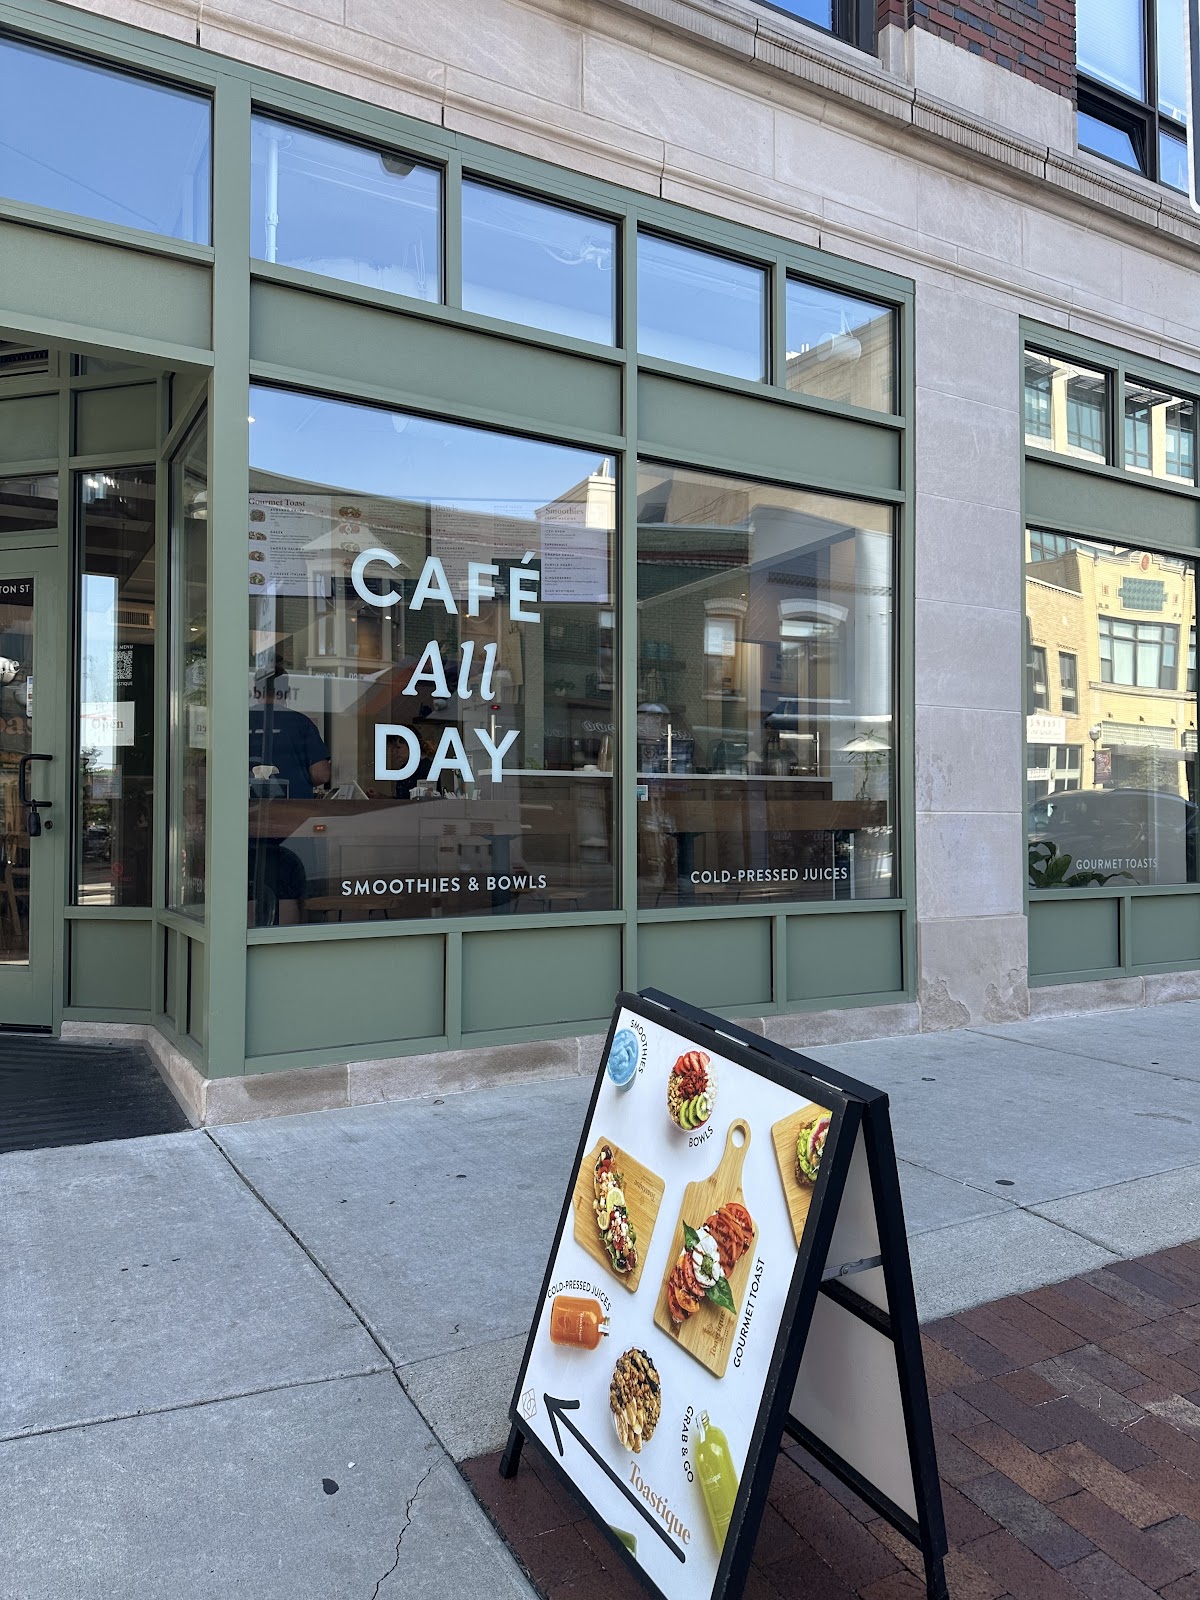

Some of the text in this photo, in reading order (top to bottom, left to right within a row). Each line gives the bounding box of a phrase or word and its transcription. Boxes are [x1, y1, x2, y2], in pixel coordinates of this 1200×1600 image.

[284, 499, 306, 507] Toast
[435, 504, 458, 512] Bowls
[545, 507, 584, 515] Smoothies
[20, 584, 30, 593] ST
[351, 547, 541, 624] CAFÉ
[401, 640, 498, 701] All
[92, 718, 124, 732] Open
[374, 723, 521, 783] DAY
[1076, 857, 1158, 870] GOURMET TOASTS
[341, 874, 547, 896] SMOOTHIES & BOWLS
[690, 867, 848, 884] COLD-PRESSED JUICES
[630, 1019, 648, 1074] SMOOTHIES
[688, 1125, 714, 1148] BOWLS
[547, 1280, 612, 1312] COLD-PRESSED JUICES
[733, 1257, 765, 1368] GOURMET TOAST
[681, 1405, 694, 1483] GRAB & GO
[629, 1460, 691, 1545] Toastique
